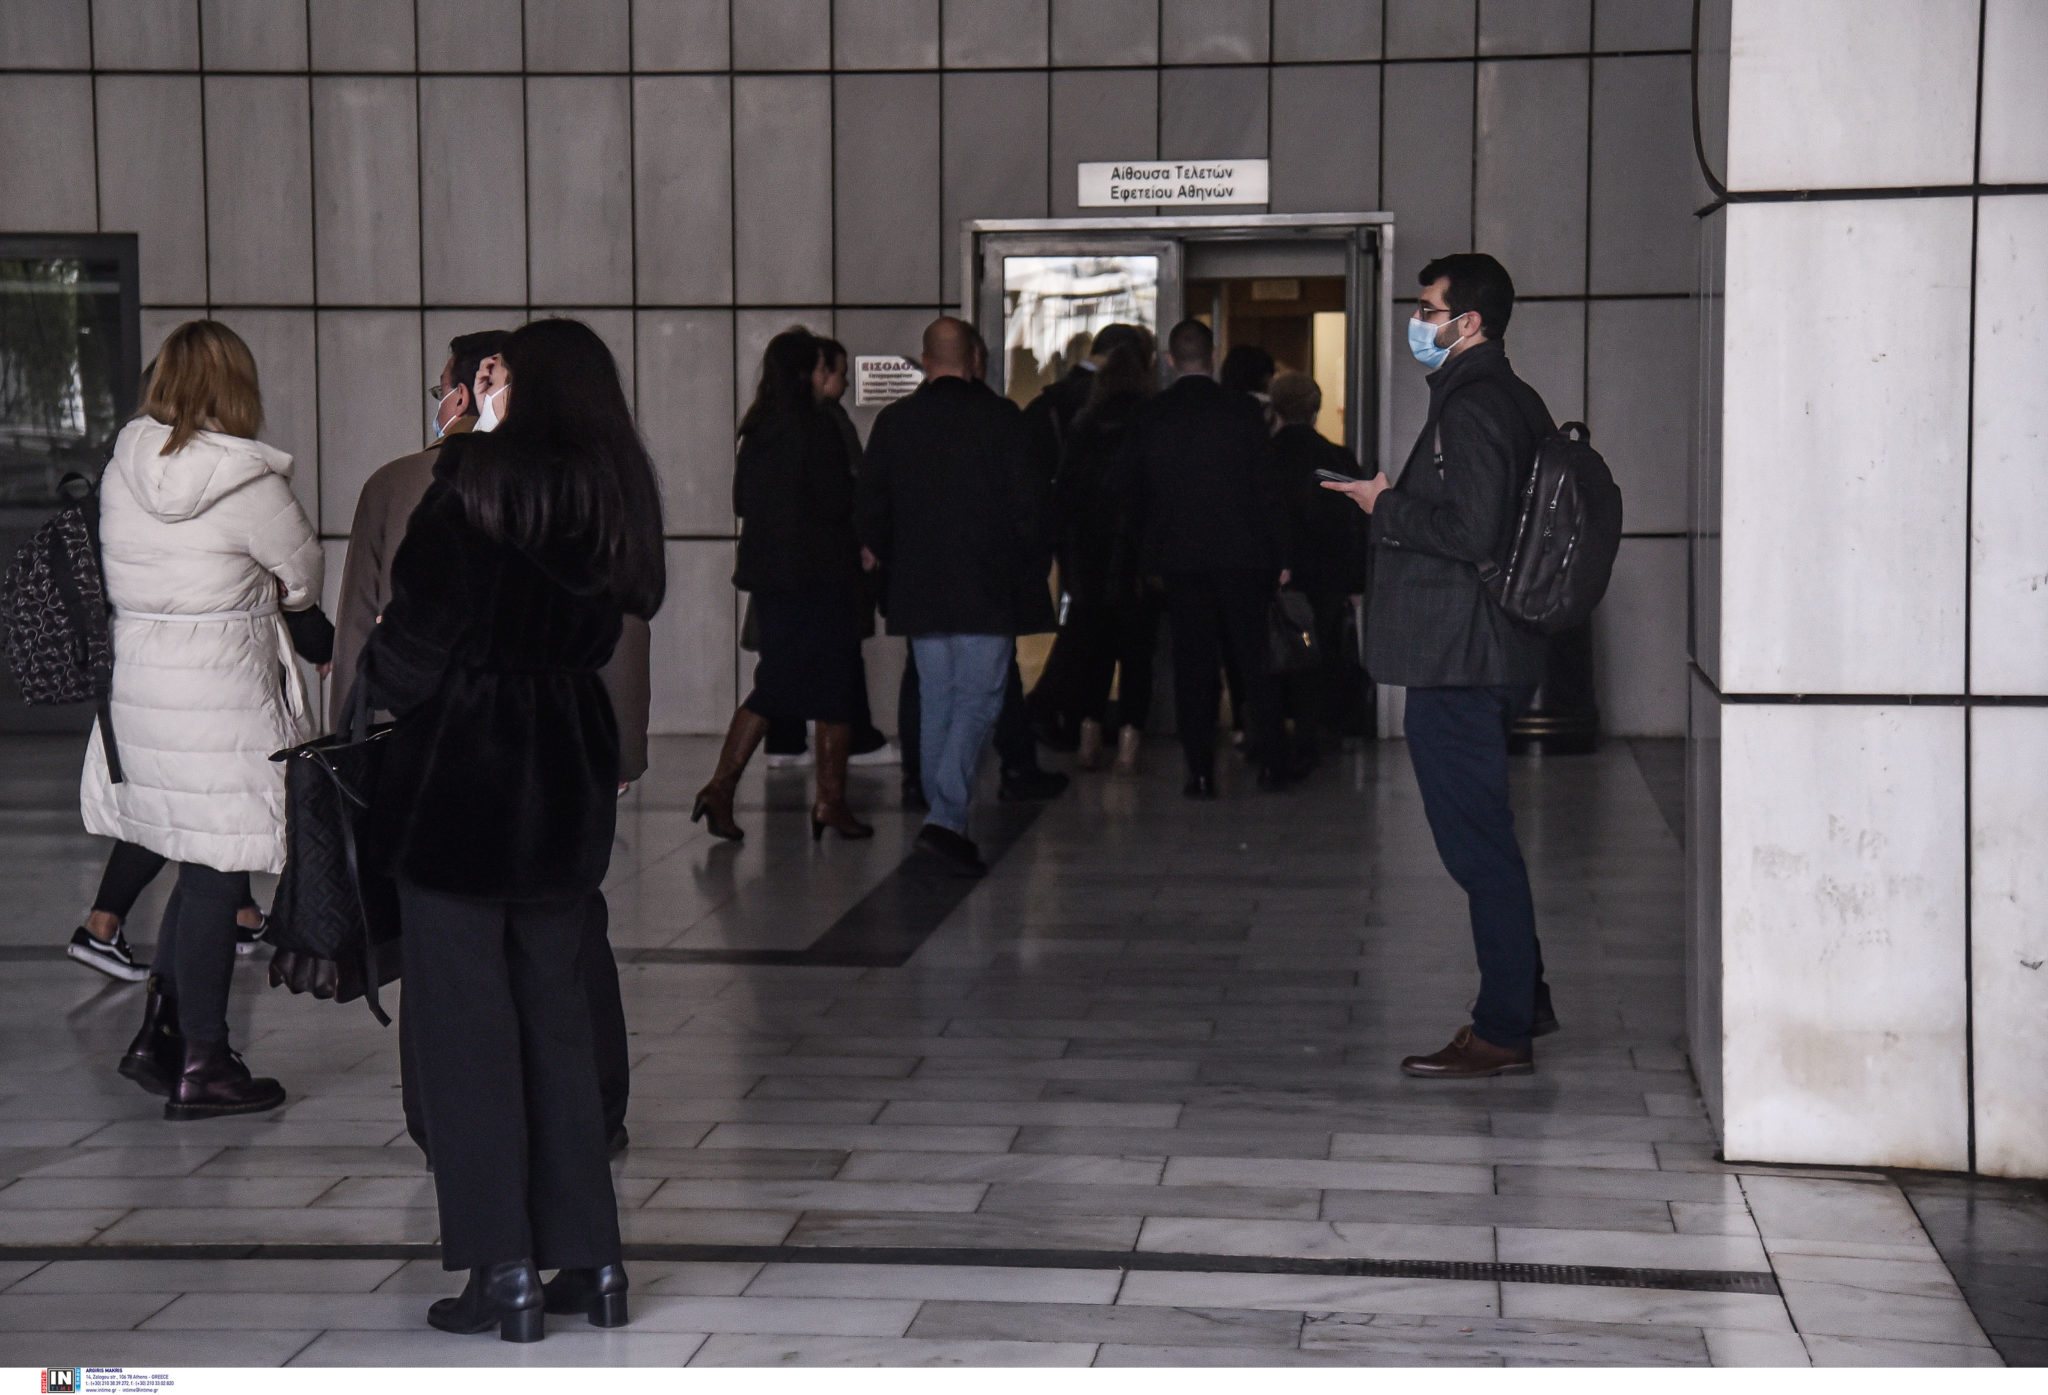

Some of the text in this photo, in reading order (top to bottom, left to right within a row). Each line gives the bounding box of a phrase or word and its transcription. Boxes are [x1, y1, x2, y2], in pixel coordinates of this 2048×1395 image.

[1111, 164, 1233, 180] Αίθουσα Τελετών
[1111, 183, 1234, 202] Εφετείου Αθηνών
[862, 362, 915, 371] ΕΙΣΟΔΟ
